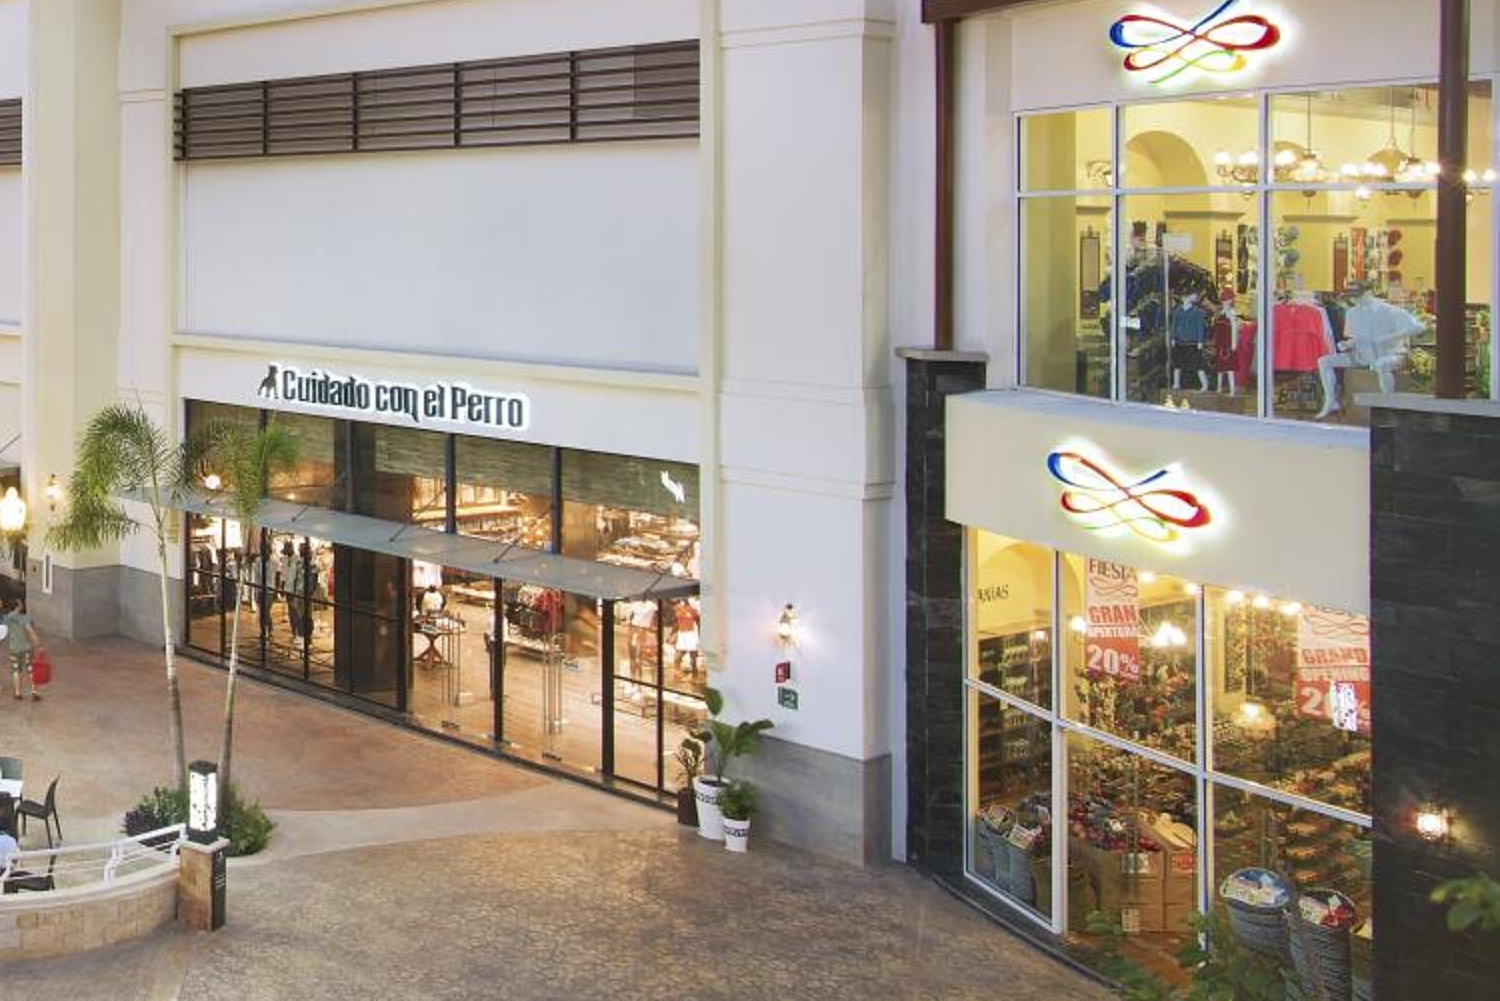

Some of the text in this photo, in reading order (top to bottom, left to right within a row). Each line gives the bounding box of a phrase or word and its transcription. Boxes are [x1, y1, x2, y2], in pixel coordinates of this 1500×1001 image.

[282, 369, 524, 428] Cuidado con el Perro
[1088, 603, 1137, 625] GRAN
[1086, 643, 1140, 676] 20%
[1301, 646, 1367, 665] GRAND
